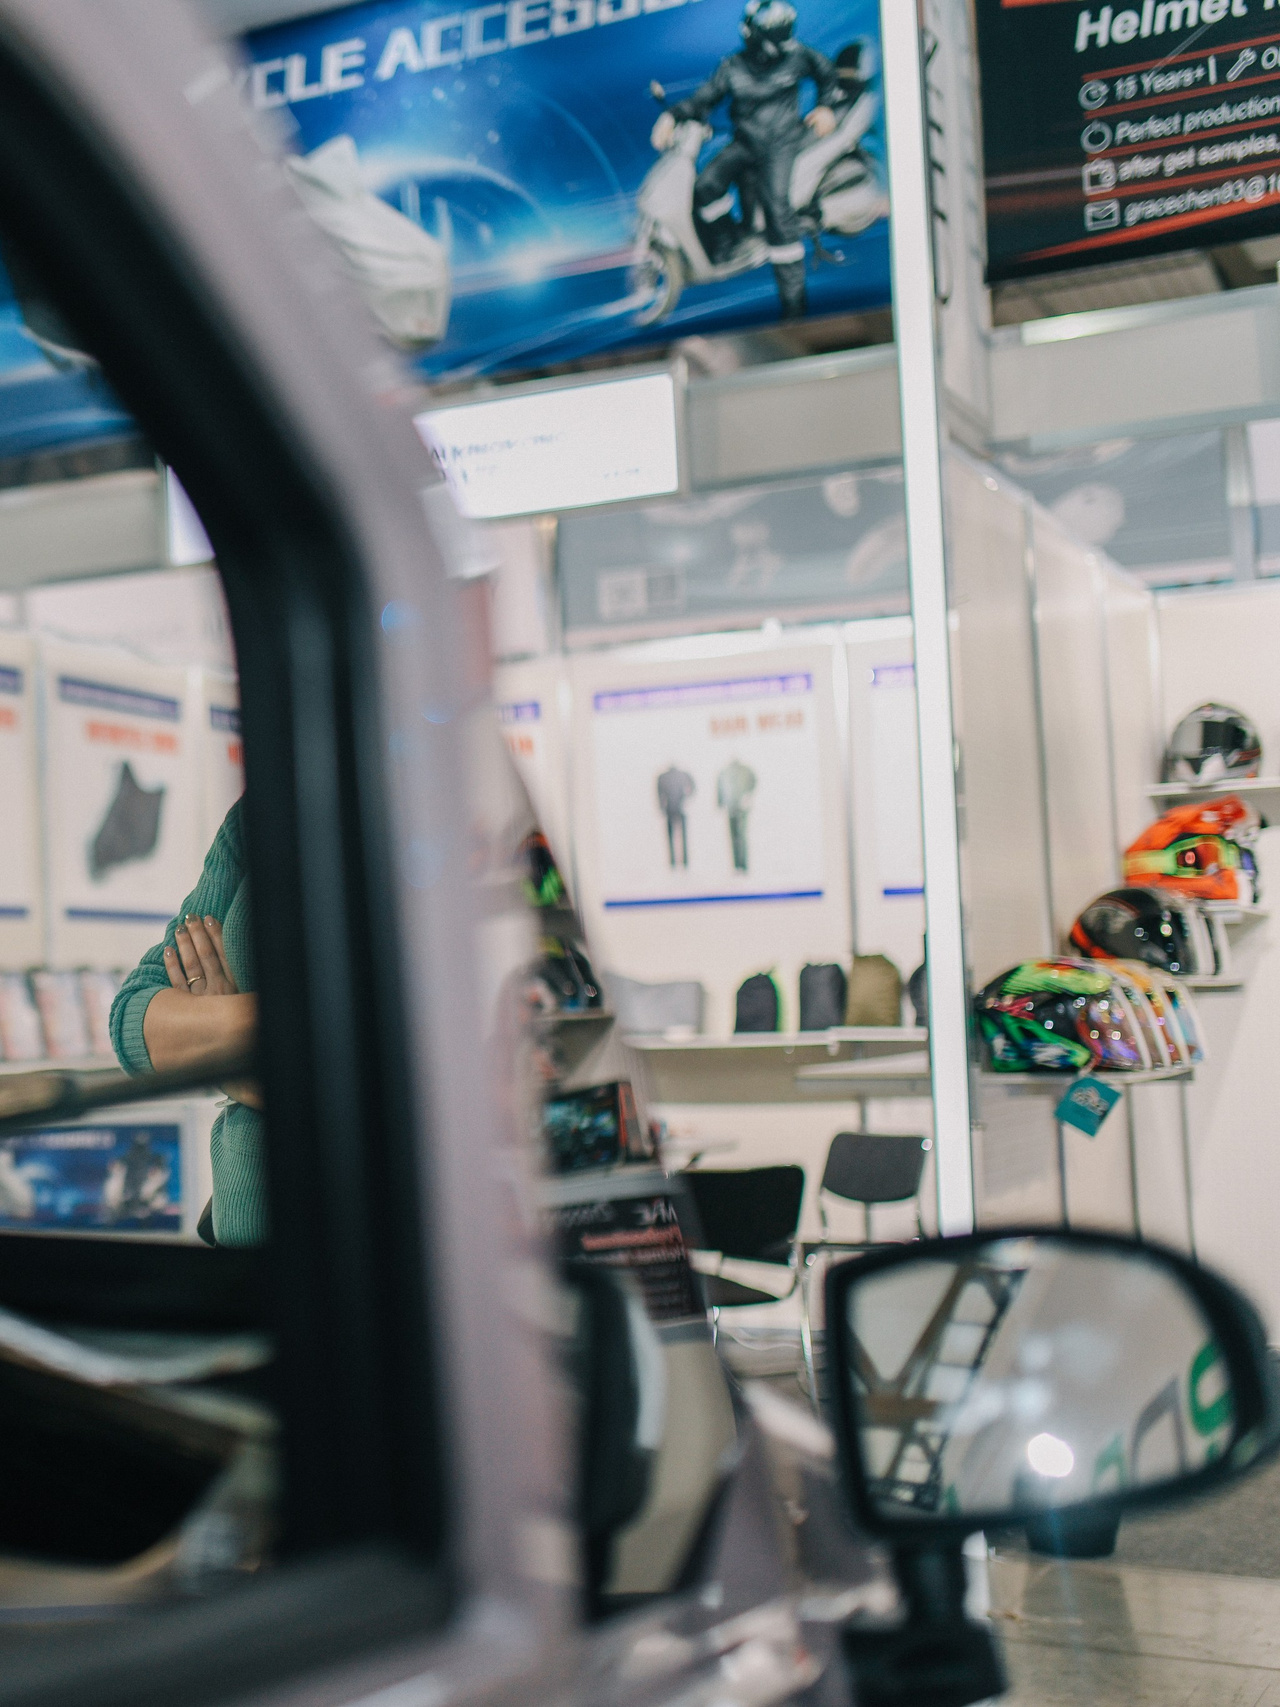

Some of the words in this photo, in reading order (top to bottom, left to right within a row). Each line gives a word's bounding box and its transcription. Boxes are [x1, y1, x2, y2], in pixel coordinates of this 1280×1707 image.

[238, 37, 367, 108] CLE
[1115, 114, 1182, 146] Perfect
[1118, 154, 1163, 181] after
[1163, 146, 1196, 177] get
